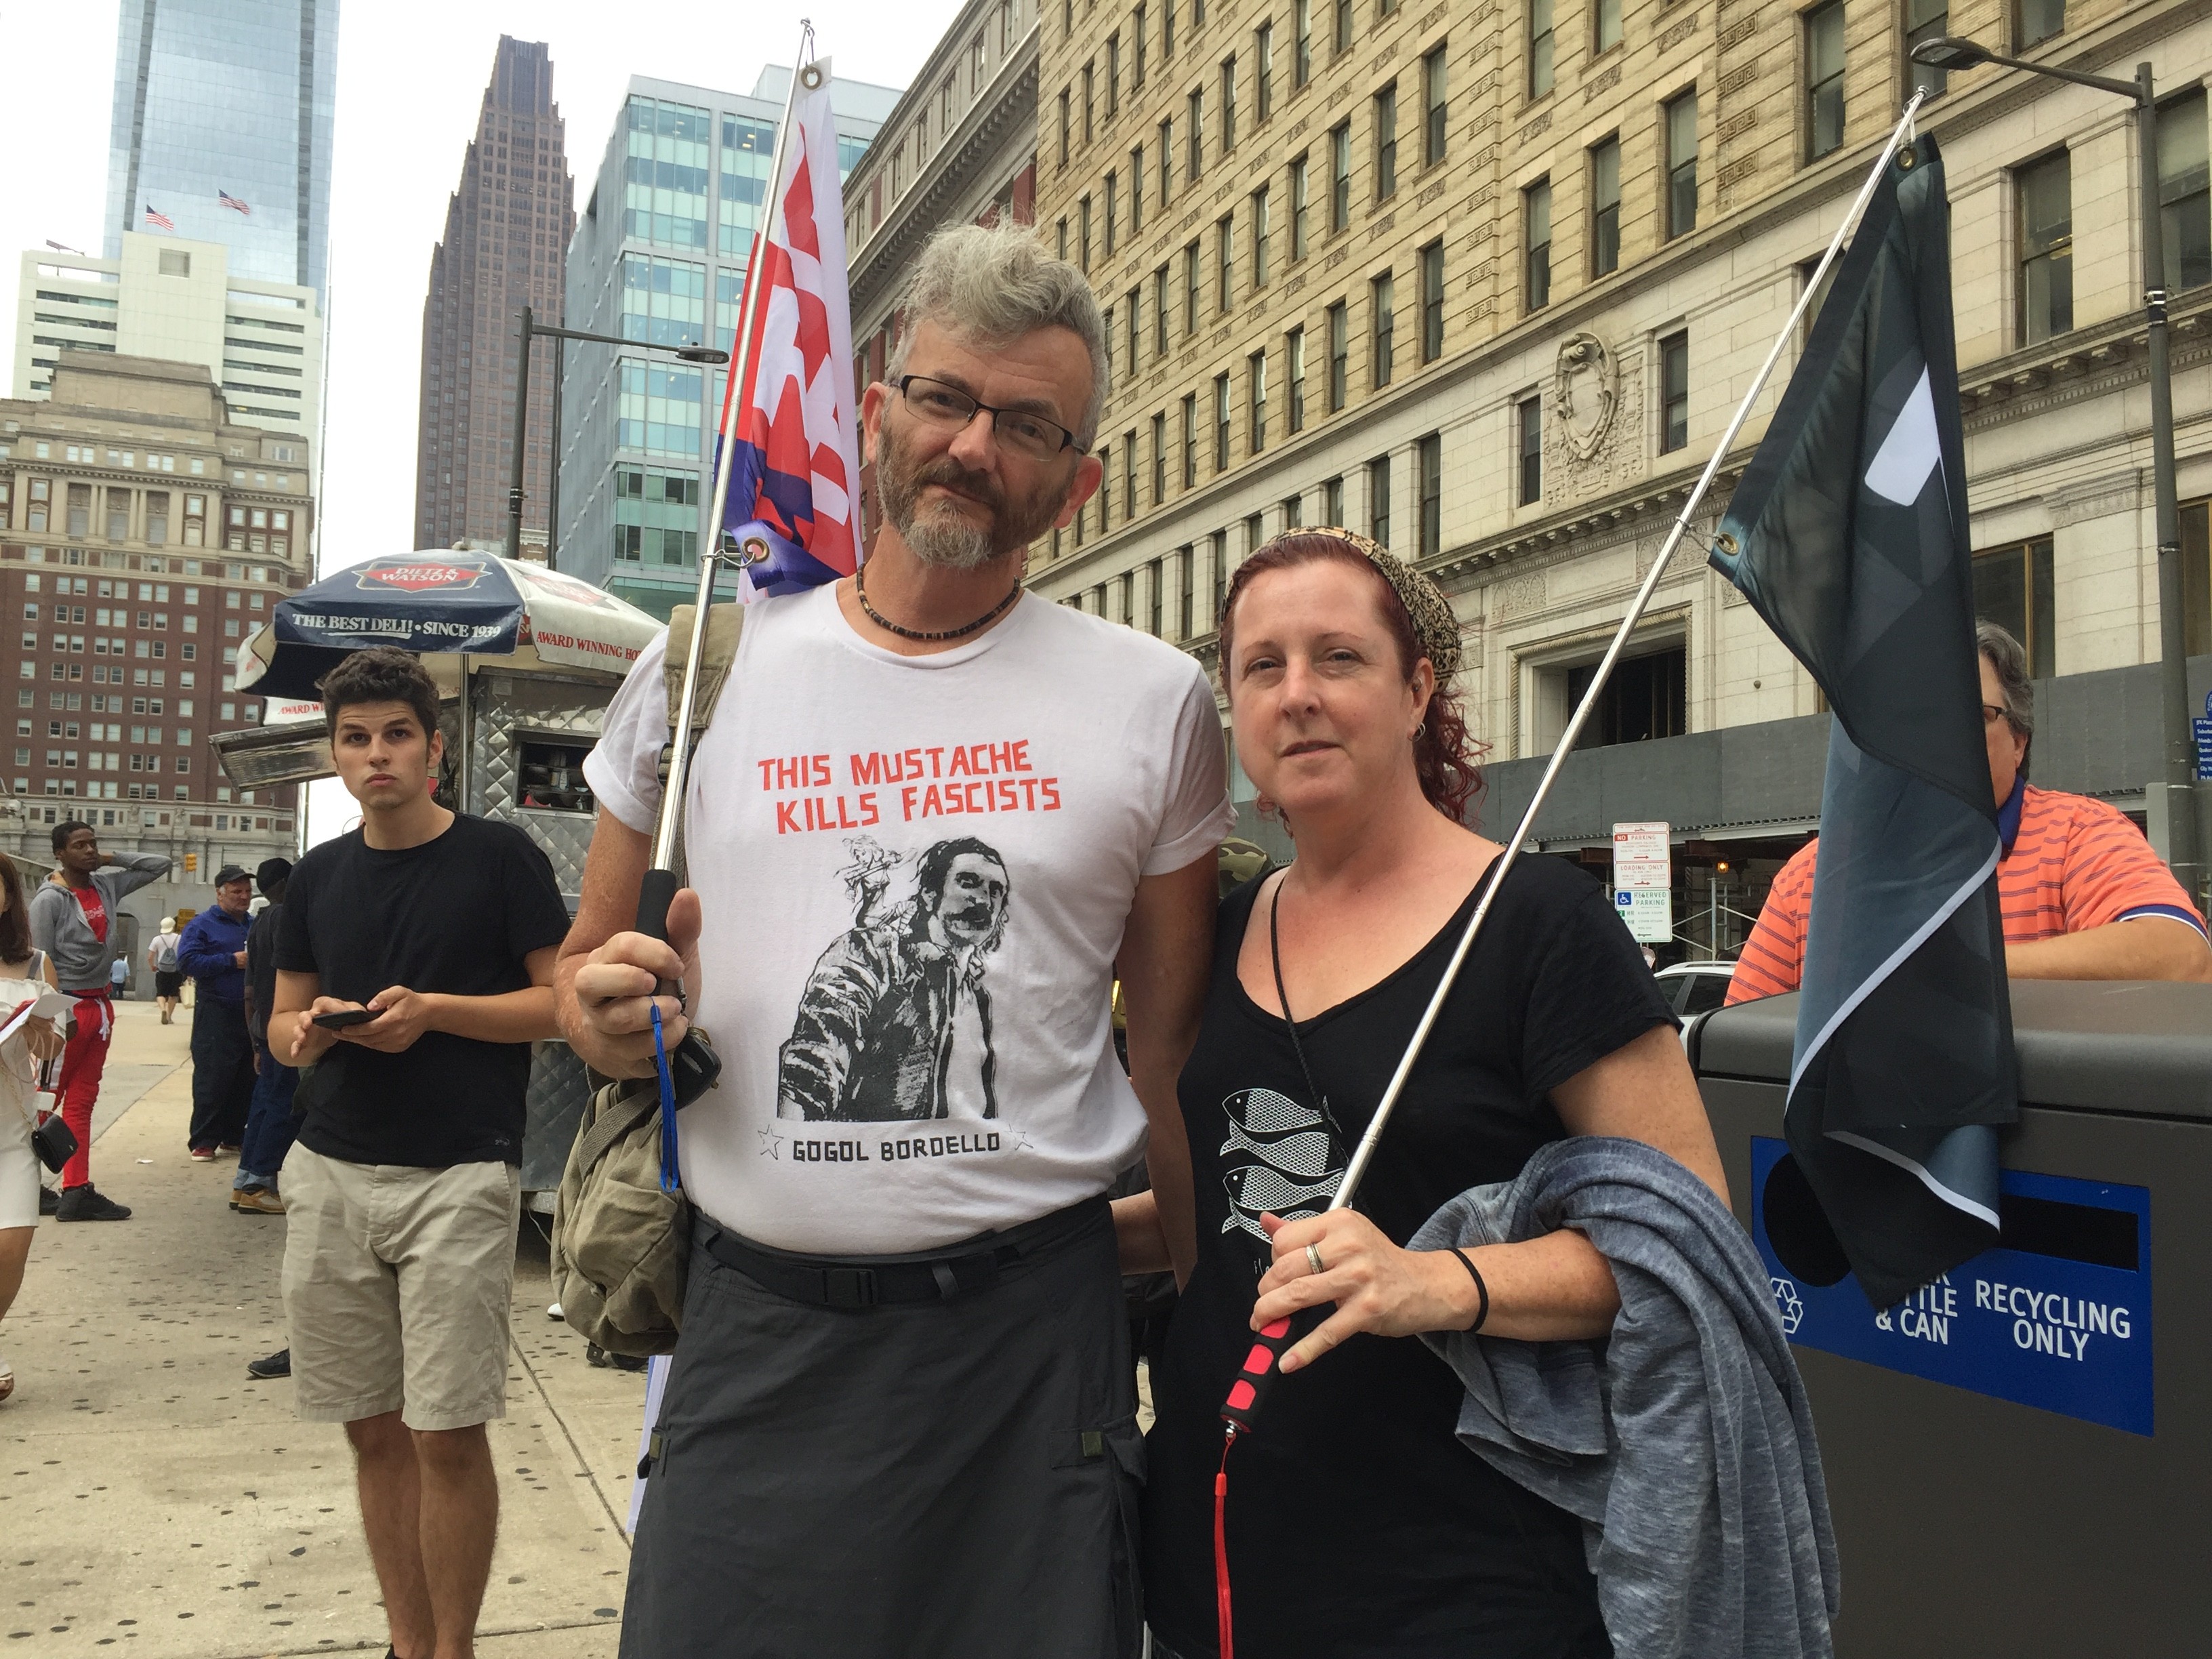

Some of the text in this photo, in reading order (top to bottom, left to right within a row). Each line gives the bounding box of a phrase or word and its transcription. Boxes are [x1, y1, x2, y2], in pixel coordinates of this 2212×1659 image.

[382, 573, 458, 581] WATSON
[292, 613, 501, 638] THE BEST DELI! SINCE 1939
[537, 631, 574, 649] AWARD
[576, 638, 623, 658] WINNING
[279, 701, 325, 715] AWARD WI
[758, 739, 1033, 791] THIS MUSTACHE
[776, 777, 1061, 834] KILLS FASCISTS
[793, 1132, 1000, 1162] GOGOL BORDELLO
[1875, 1307, 1948, 1345] & CAN
[1975, 1279, 2131, 1339] RECYCLING
[2013, 1319, 2090, 1361] ONLY
